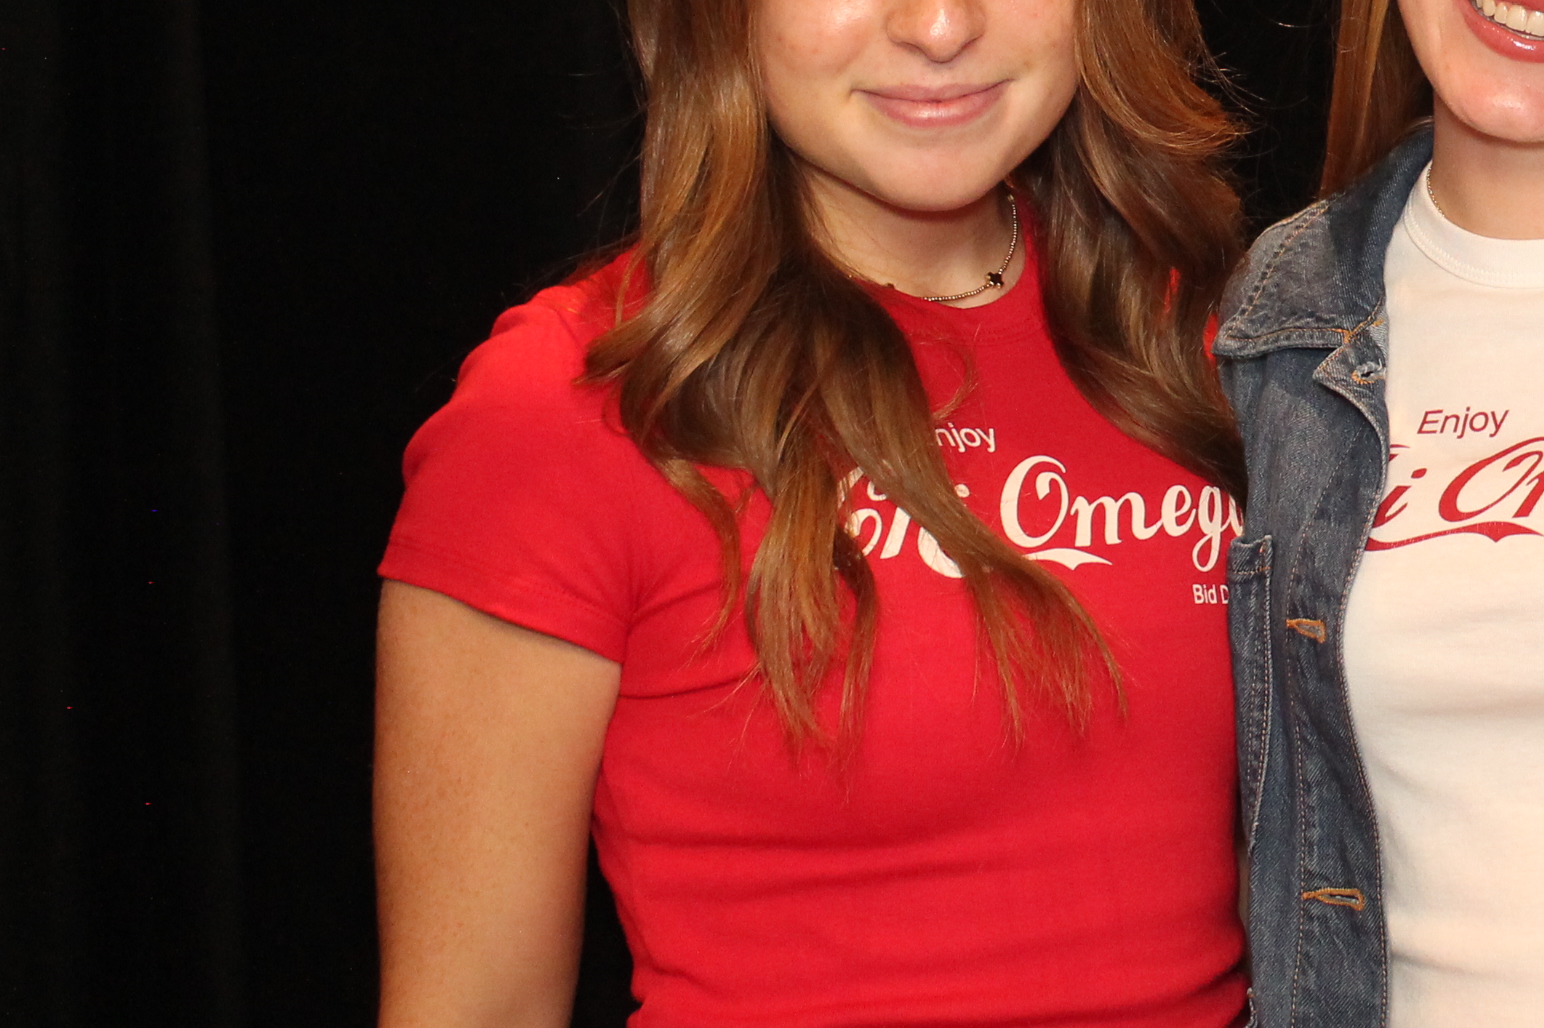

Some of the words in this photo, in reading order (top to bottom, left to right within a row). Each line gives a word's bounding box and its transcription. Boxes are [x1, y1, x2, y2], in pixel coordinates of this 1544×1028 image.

[935, 422, 996, 453] njoy
[1417, 406, 1509, 439] Enjoy
[1192, 583, 1218, 604] Bid
